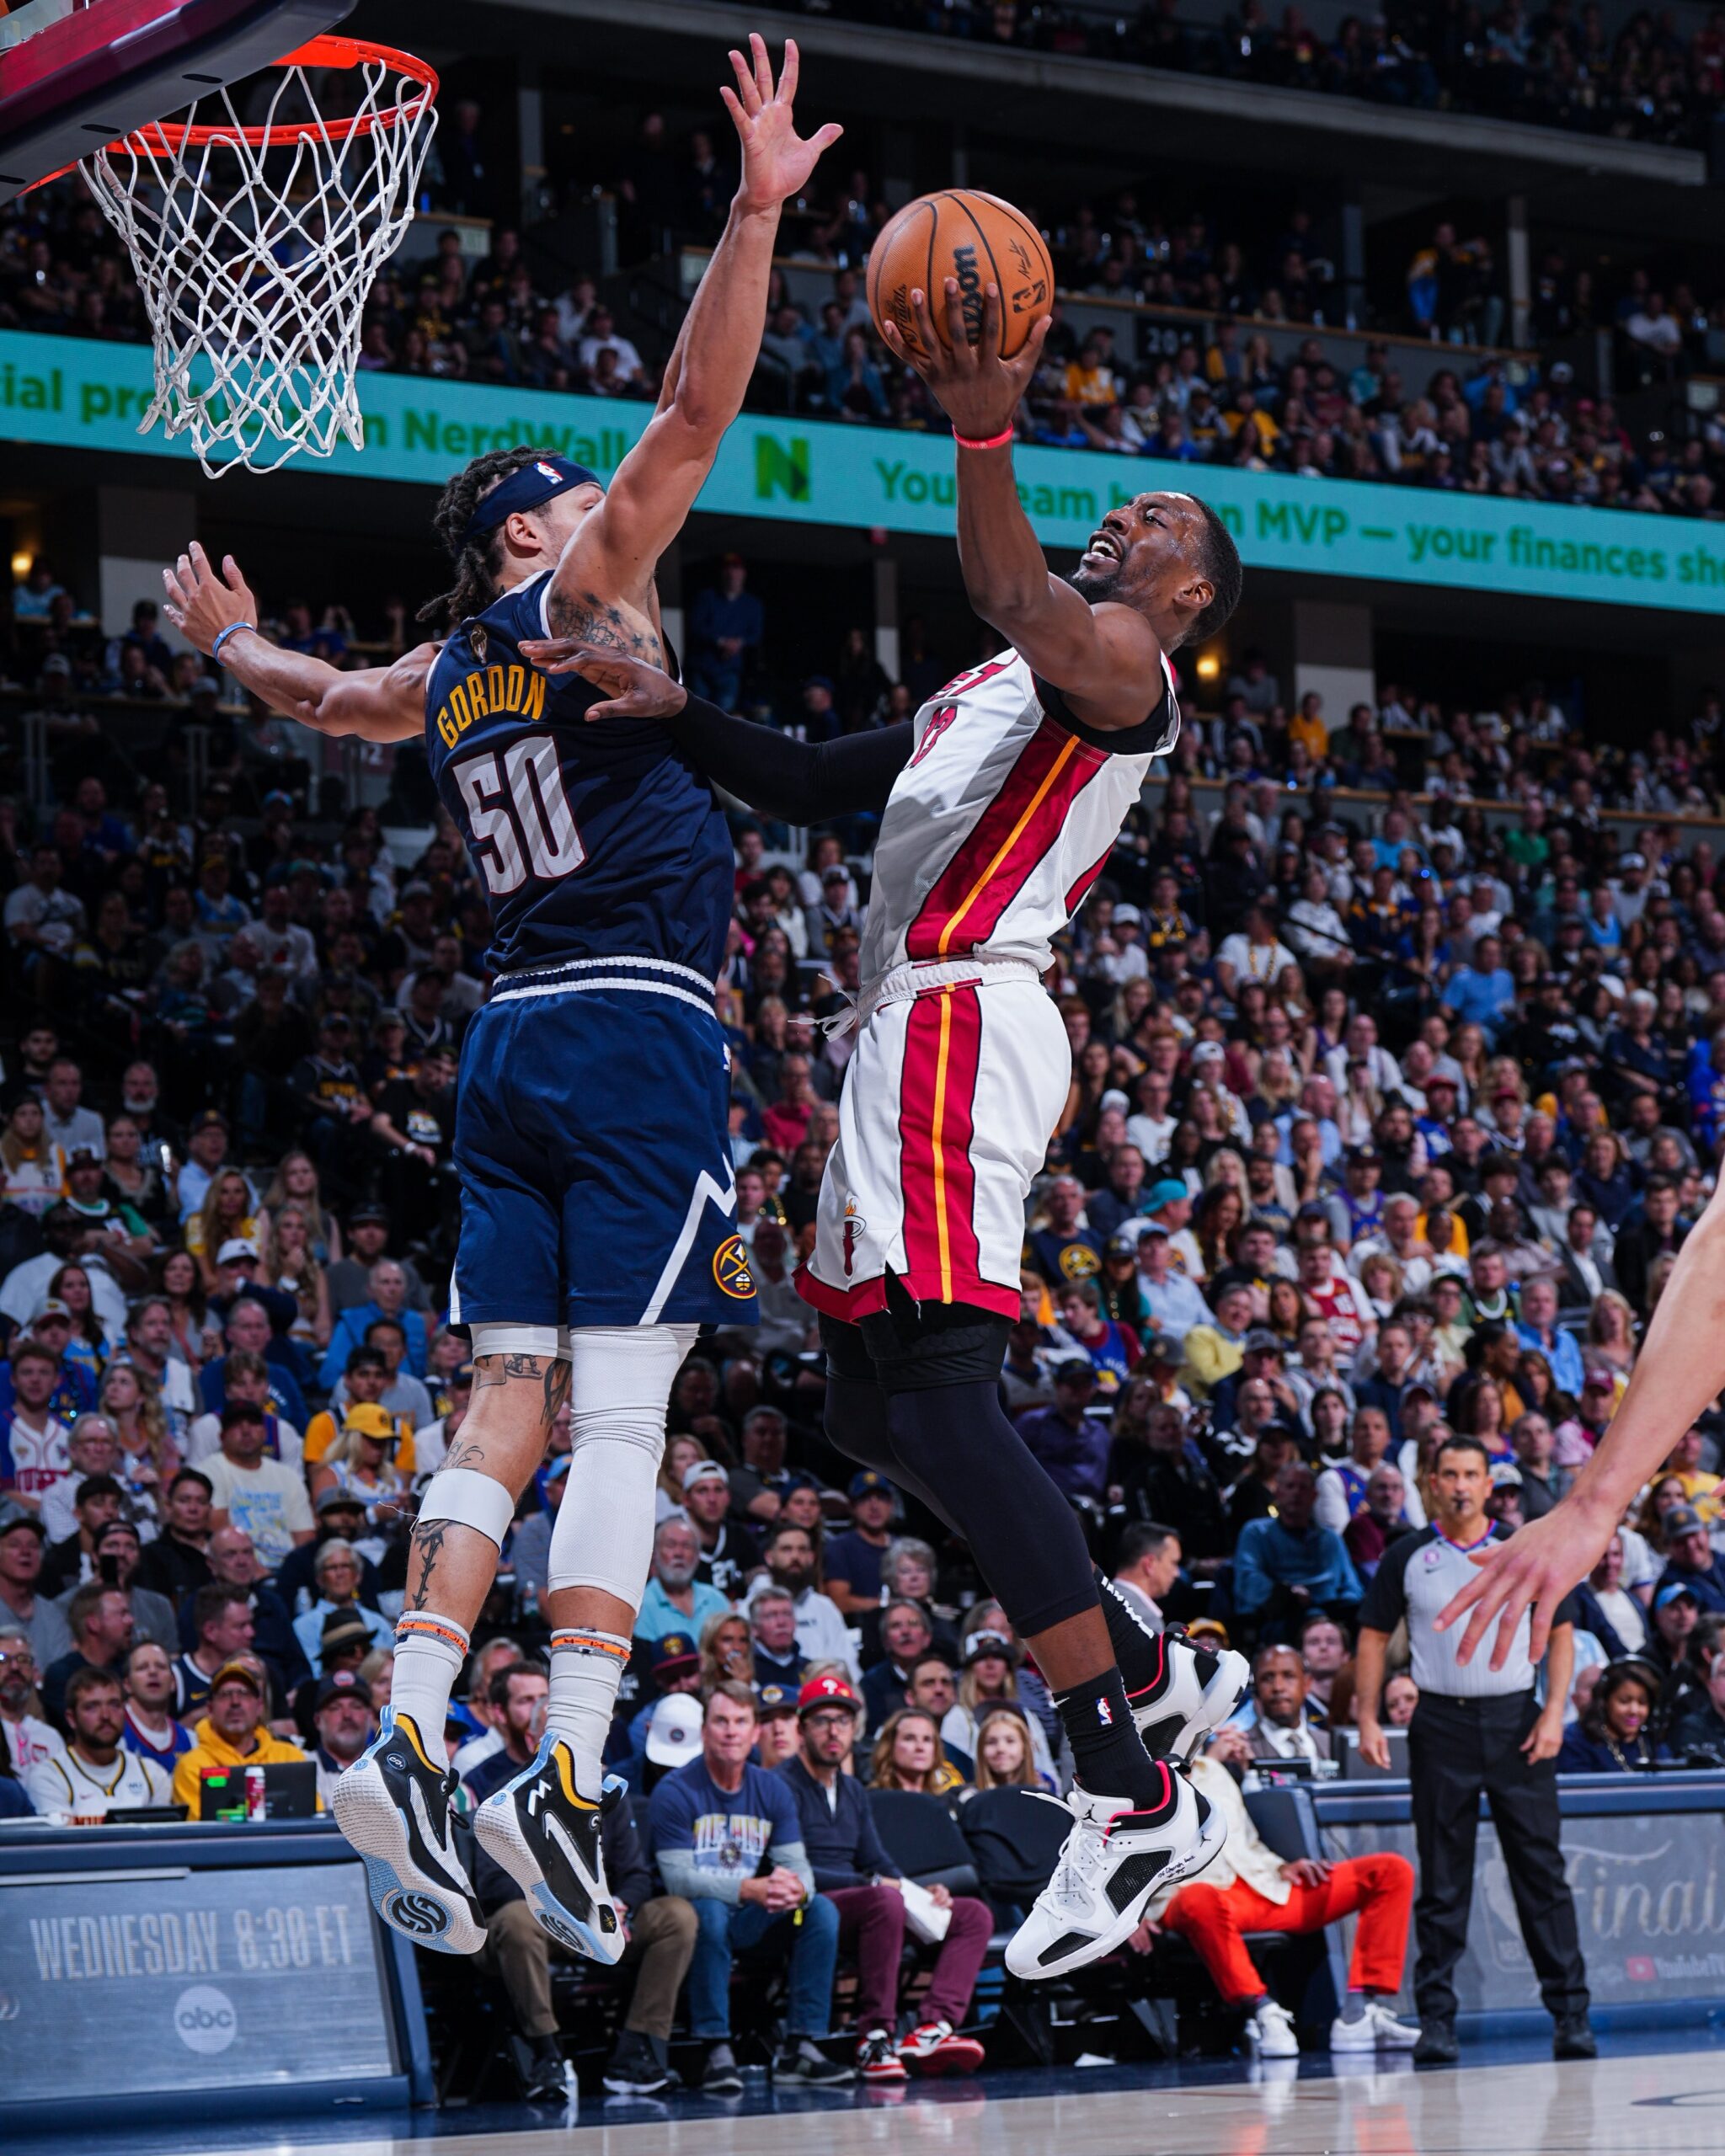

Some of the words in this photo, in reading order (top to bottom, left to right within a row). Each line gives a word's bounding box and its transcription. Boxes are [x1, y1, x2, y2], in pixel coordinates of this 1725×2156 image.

[403, 407, 628, 468] NerdWall
[877, 461, 955, 506] You
[1258, 501, 1344, 546] MVP
[1407, 525, 1497, 561] your
[1509, 529, 1664, 579] finances
[1679, 546, 1725, 586] sh
[437, 665, 546, 750] GORDON
[451, 733, 587, 896] 50
[29, 1910, 220, 1980] WEDNESDAY
[314, 1904, 351, 1966] ET
[179, 2006, 232, 2029] abc
